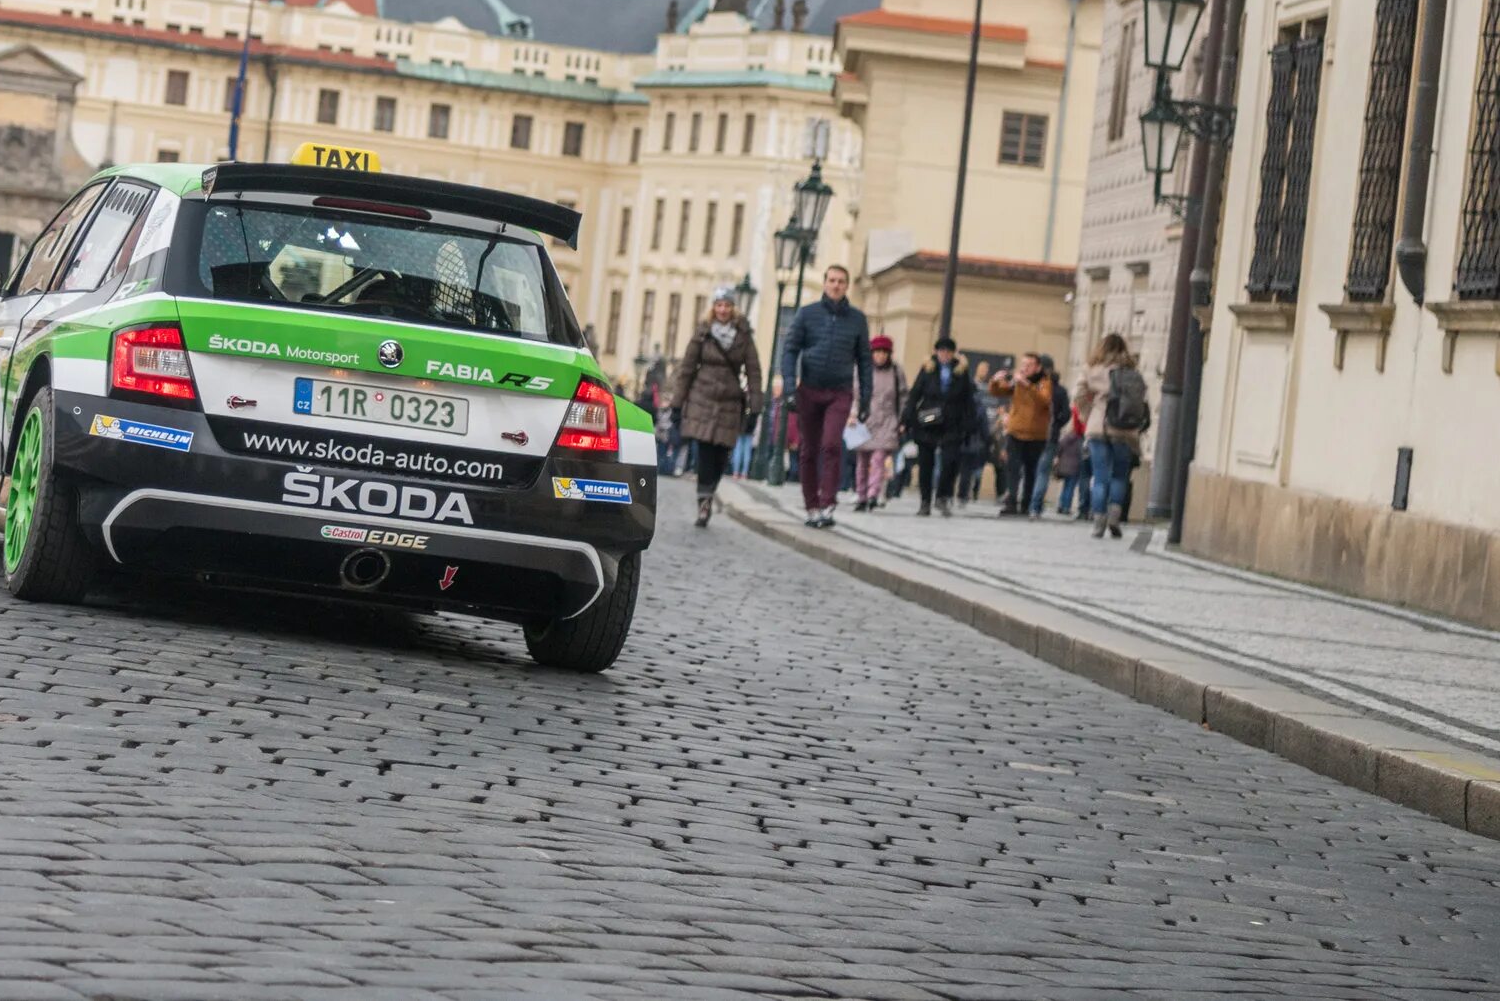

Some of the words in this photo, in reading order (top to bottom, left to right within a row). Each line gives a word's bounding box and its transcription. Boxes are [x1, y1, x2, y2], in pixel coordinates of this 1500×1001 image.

[313, 146, 369, 172] TAXI
[209, 334, 281, 356] ŠKODA
[286, 345, 360, 365] Motorsport
[426, 360, 494, 383] FABIA
[498, 372, 554, 390] R5
[297, 401, 310, 410] CZ
[320, 385, 367, 417] 11R
[390, 394, 455, 428] 0323
[127, 427, 190, 443] MICHELIN
[243, 432, 503, 480] www.skoda-auto.com
[282, 465, 474, 524] ŠKODA
[584, 485, 629, 496] MICHELIN
[332, 528, 364, 539] Castrol
[366, 530, 430, 549] EDGE
